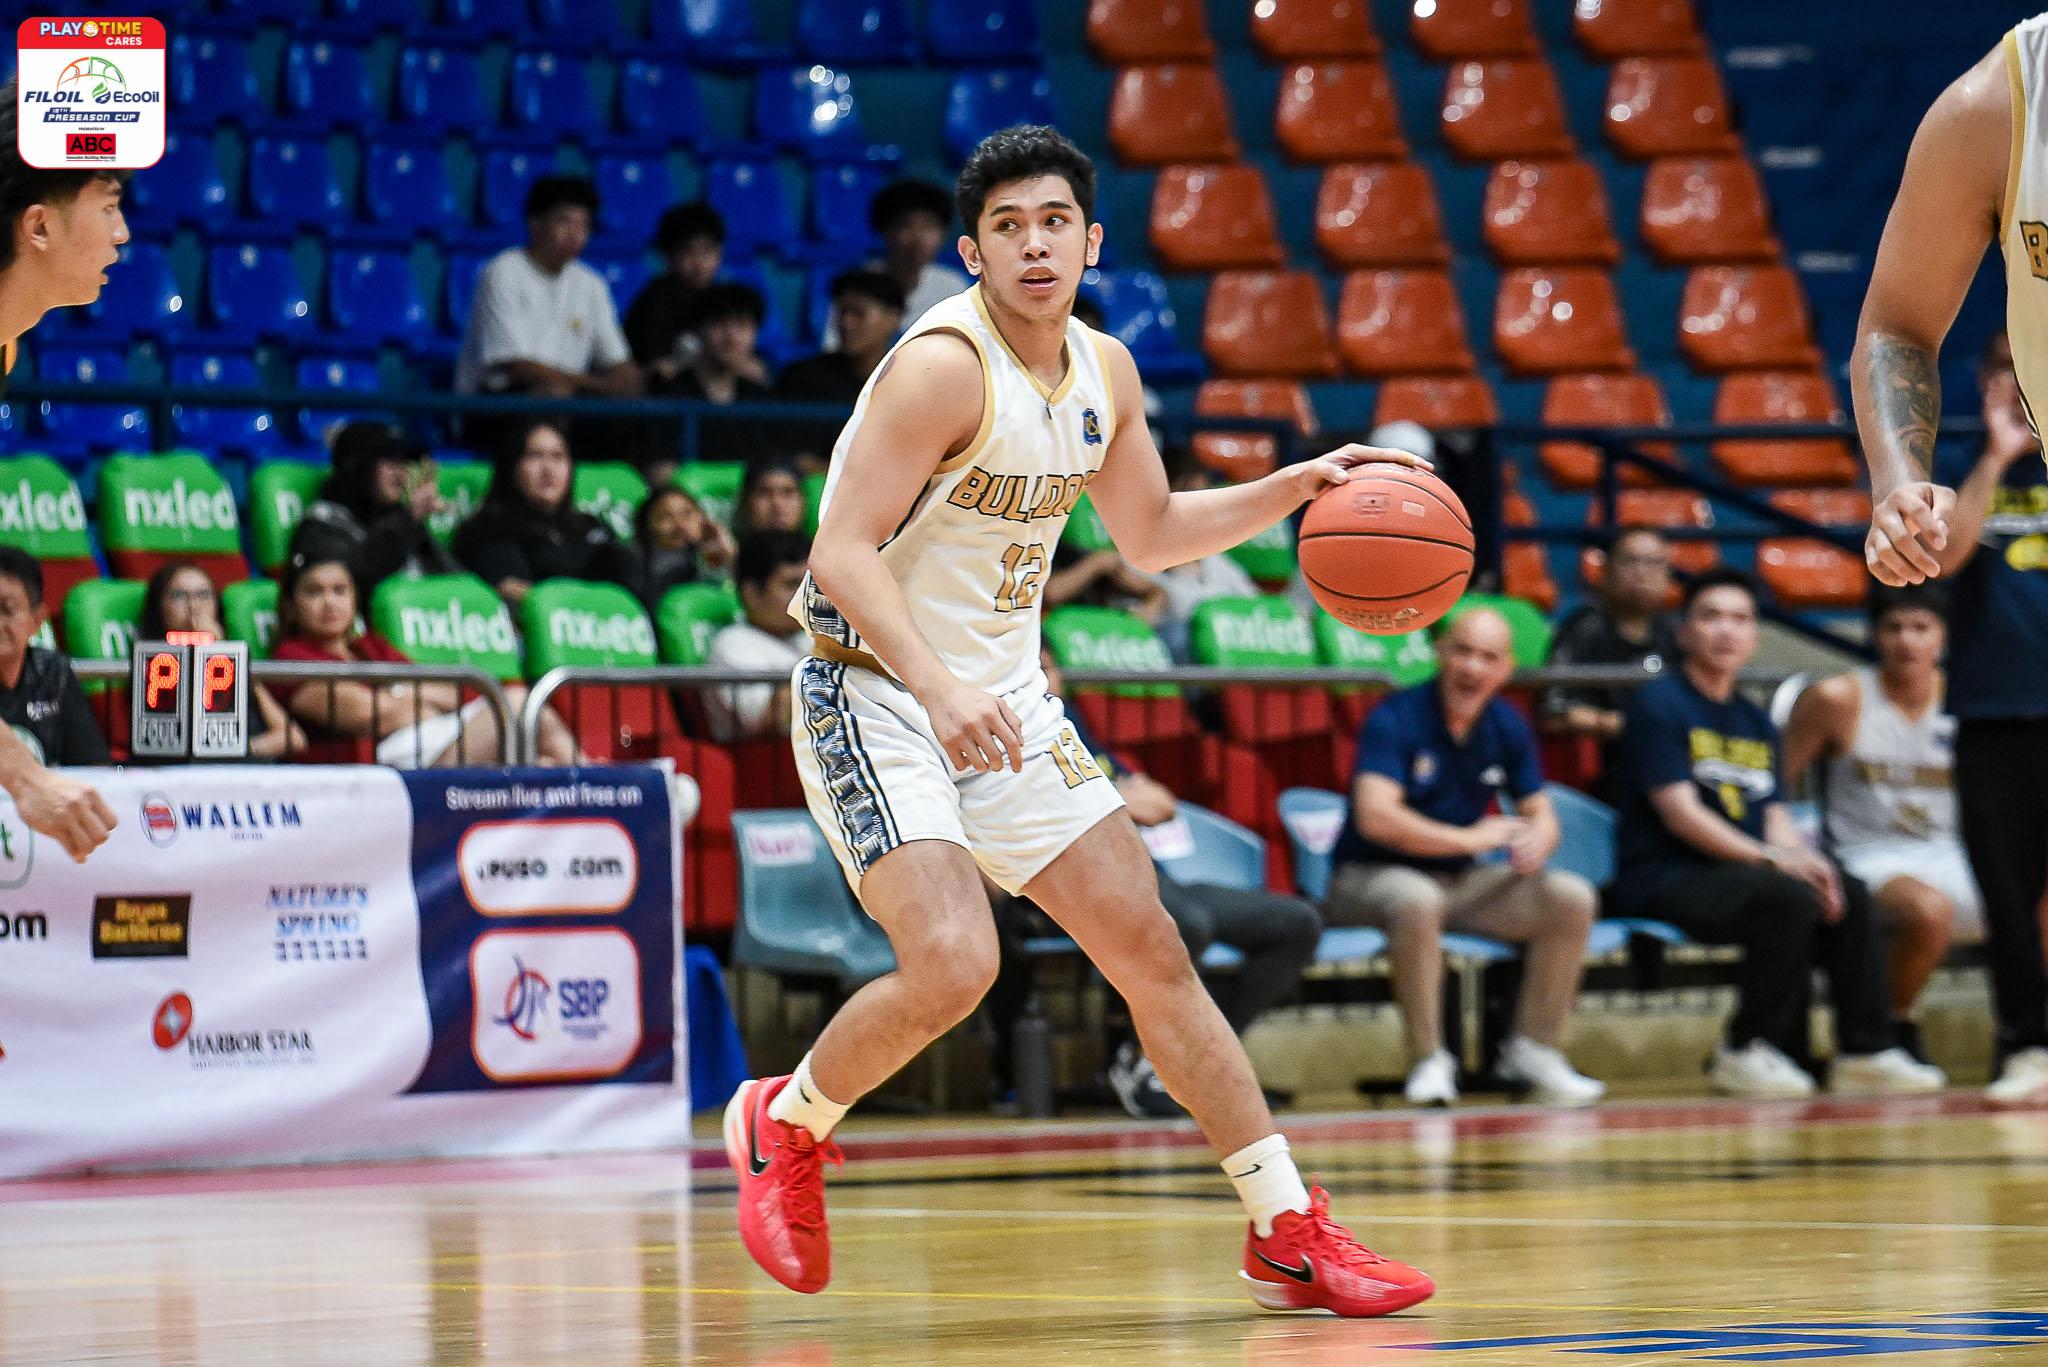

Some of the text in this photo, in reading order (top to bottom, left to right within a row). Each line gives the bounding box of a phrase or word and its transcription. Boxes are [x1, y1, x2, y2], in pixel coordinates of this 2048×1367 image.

[124, 477, 238, 530] nxled
[946, 465, 1100, 523] BULLDO
[994, 542, 1048, 612] 12
[401, 600, 517, 655] nxled
[147, 652, 234, 709] P P
[1043, 727, 1103, 789] 12
[181, 802, 302, 831] WALLEM
[446, 782, 642, 809] Stream live and free on
[559, 979, 609, 1018] SBP
[187, 1029, 313, 1055] HARBOR STAR
